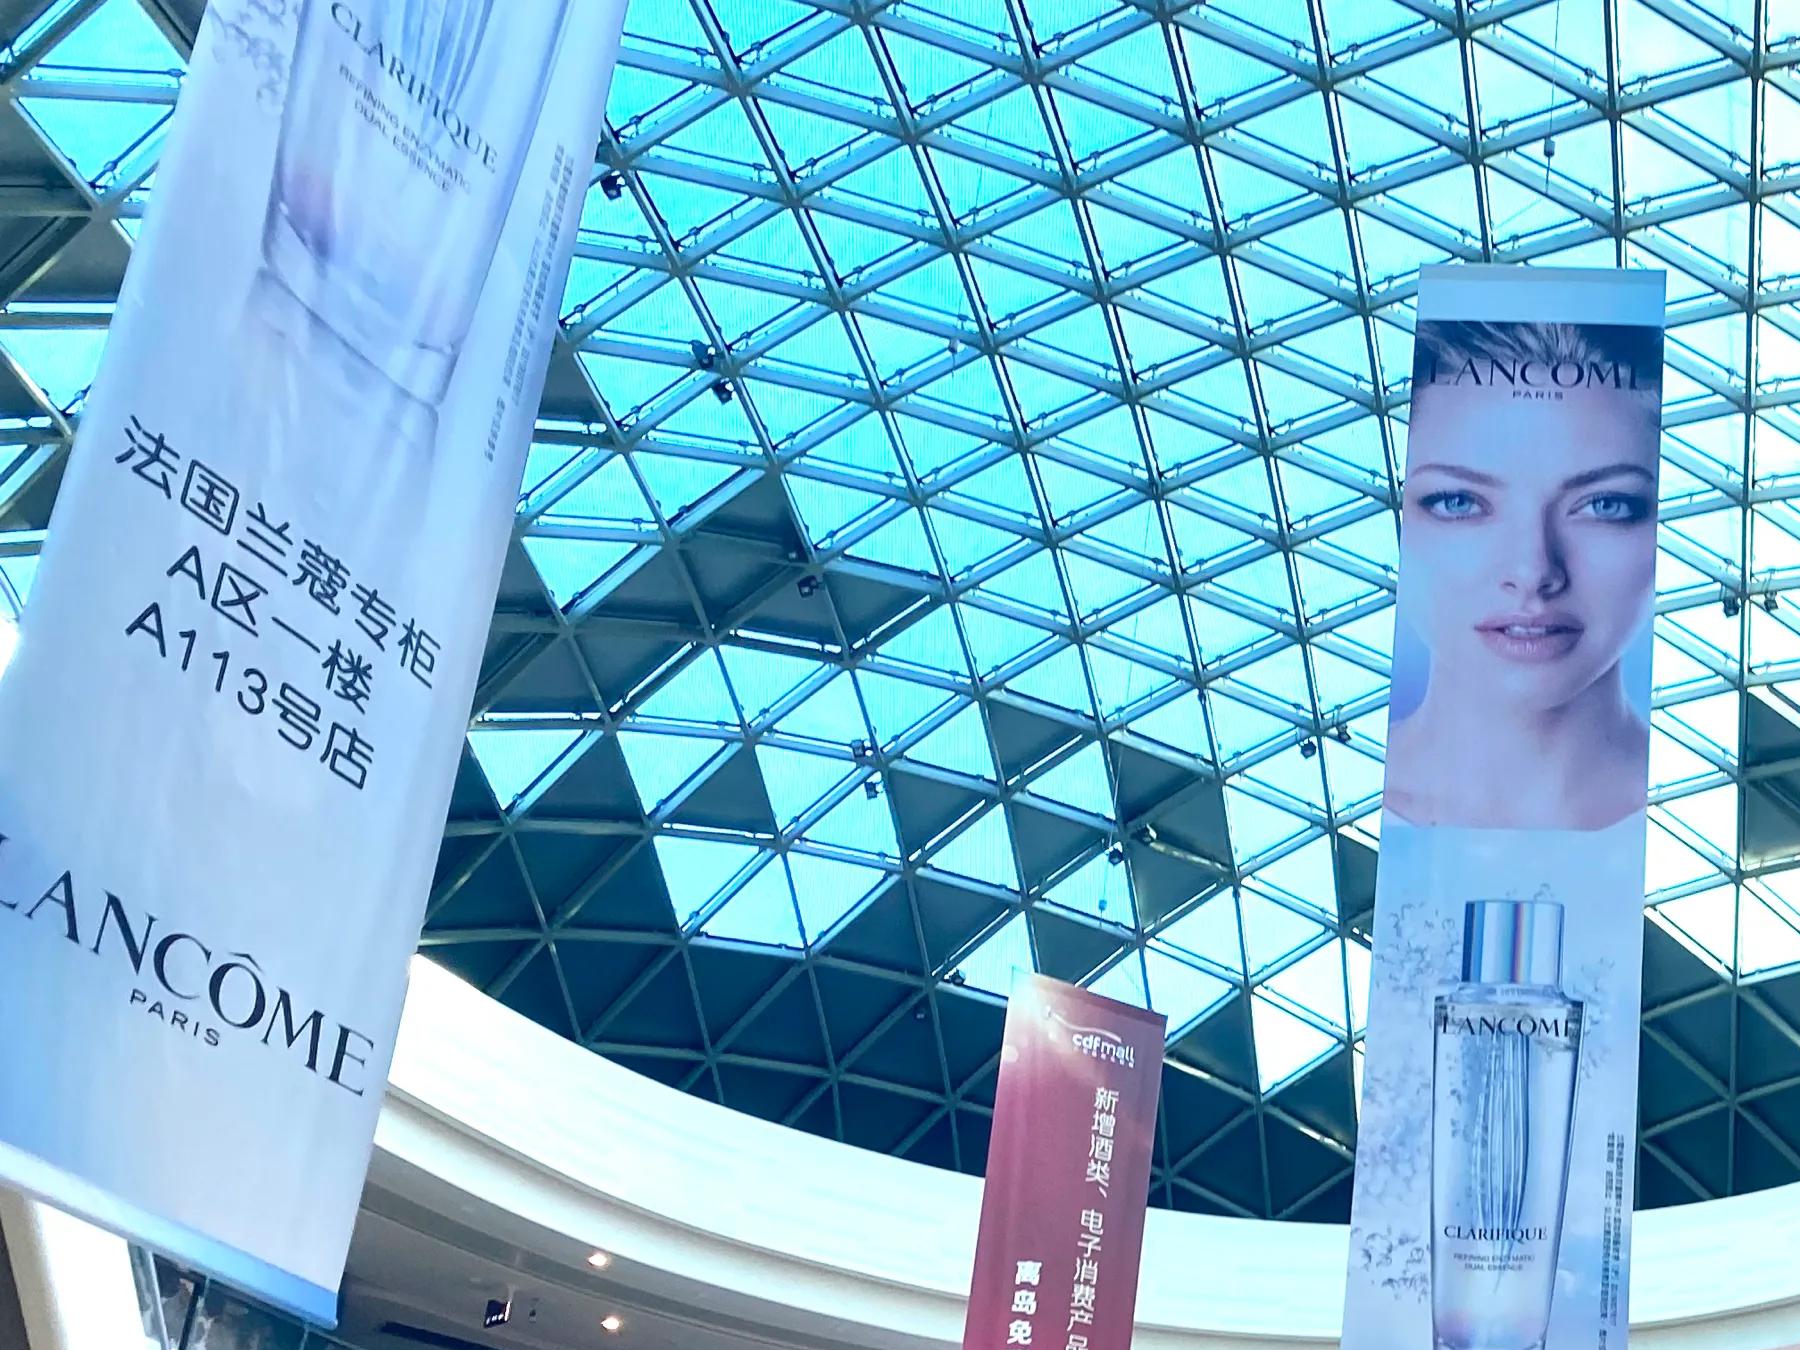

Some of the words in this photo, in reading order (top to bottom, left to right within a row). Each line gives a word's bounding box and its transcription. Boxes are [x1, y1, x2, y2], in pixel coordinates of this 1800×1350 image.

[331, 2, 498, 174] CLARIFIQUE
[1512, 390, 1563, 400] PARIS
[115, 414, 441, 689] 法国兰蔻专柜
[166, 545, 373, 714] A区一楼
[125, 602, 375, 789] A113号店
[0, 833, 375, 1097] ANCÔME
[129, 987, 221, 1048] PARIS
